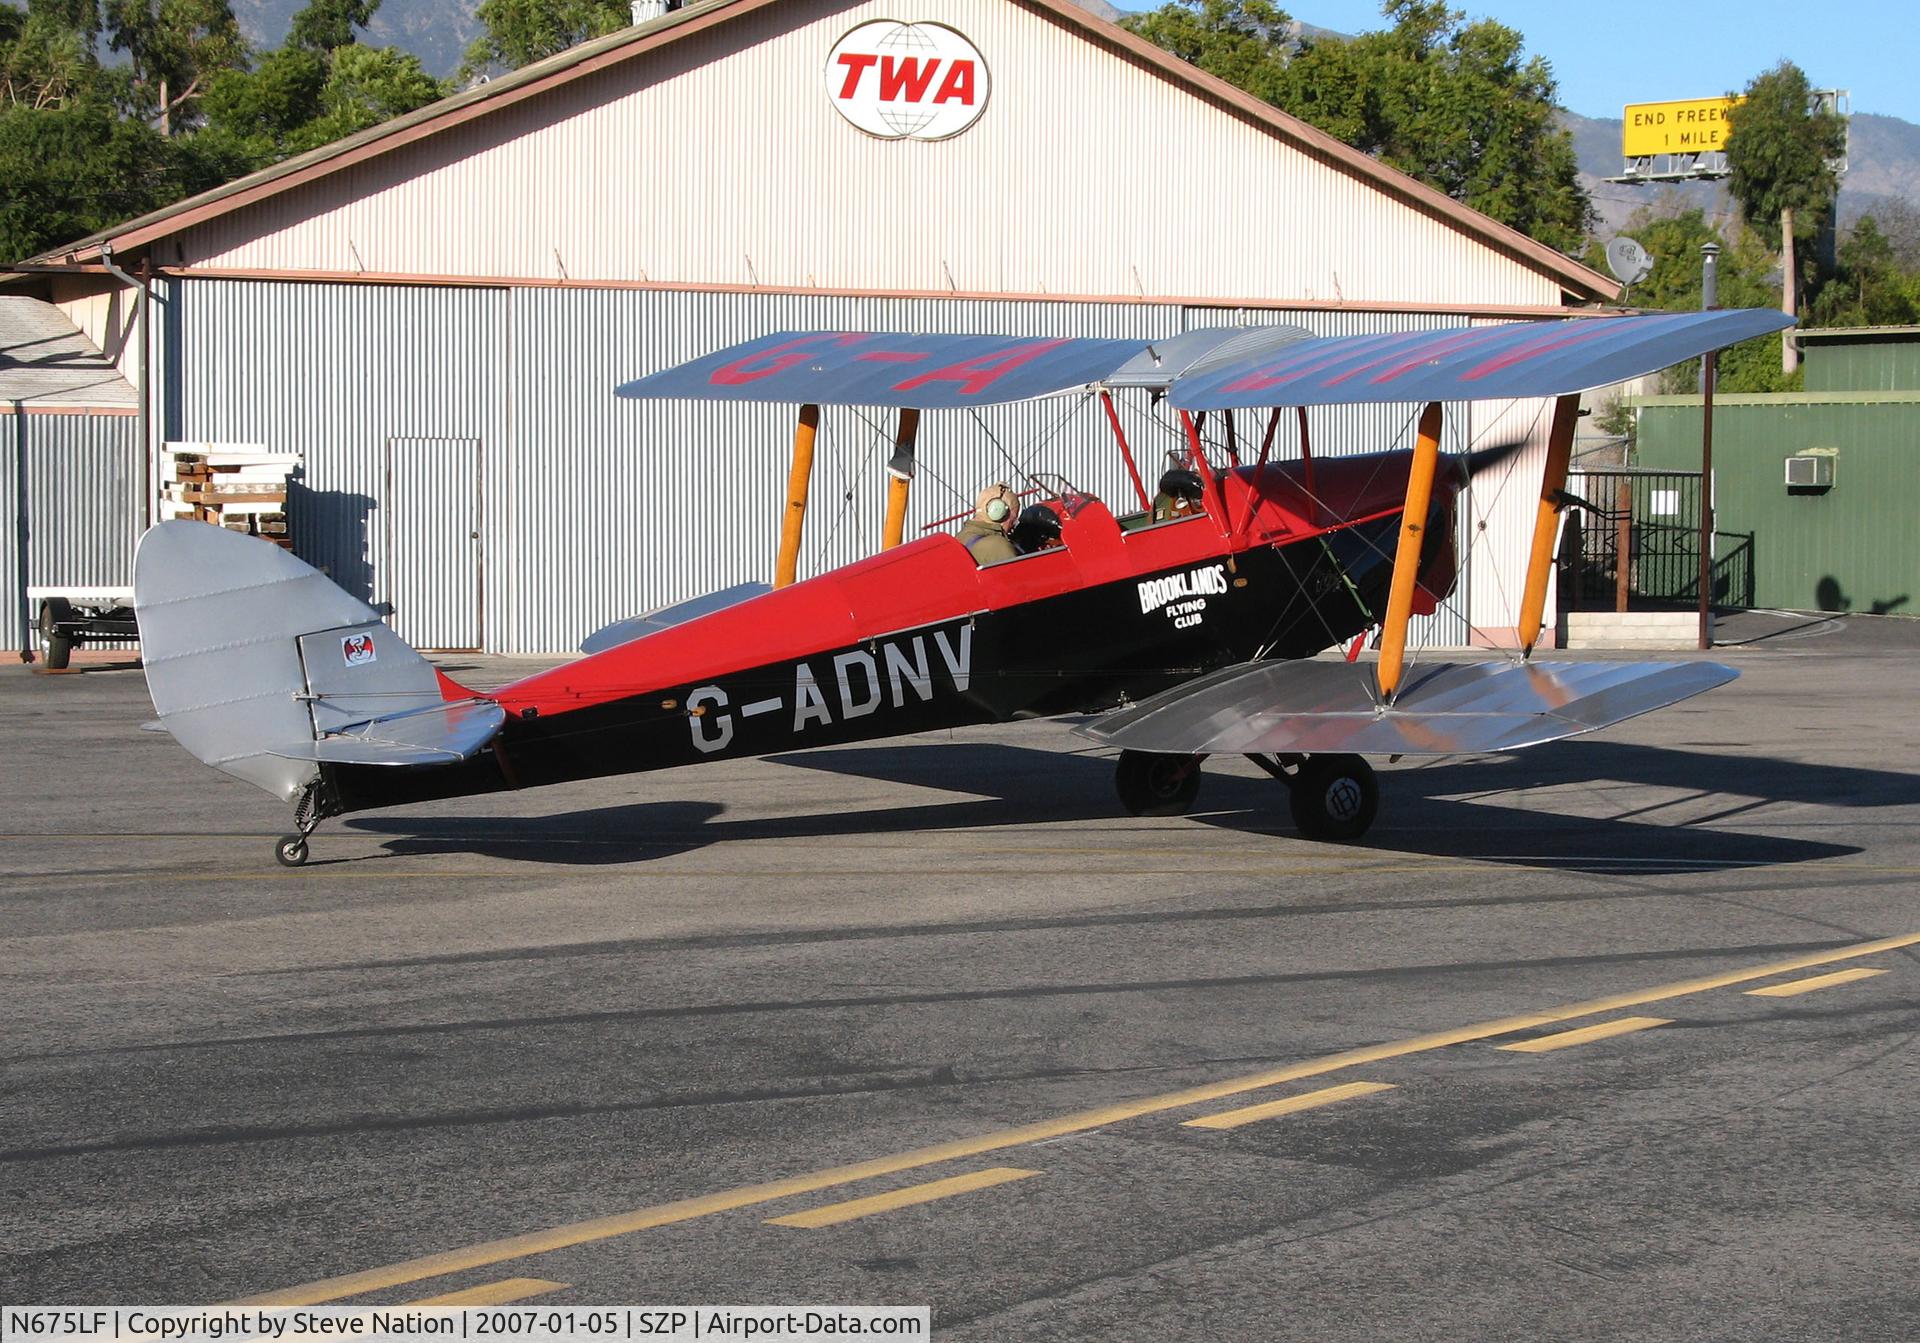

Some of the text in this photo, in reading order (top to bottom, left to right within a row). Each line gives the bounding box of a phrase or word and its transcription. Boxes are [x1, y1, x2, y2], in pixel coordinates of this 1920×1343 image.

[837, 53, 974, 105] TWA
[1634, 113, 1665, 126] END
[1664, 130, 1718, 146] 1 MILE
[1138, 564, 1227, 614] BROOKLANDS
[1166, 598, 1206, 618] FLYING
[1174, 613, 1202, 629] CLUB
[686, 624, 972, 753] G-ADNV
